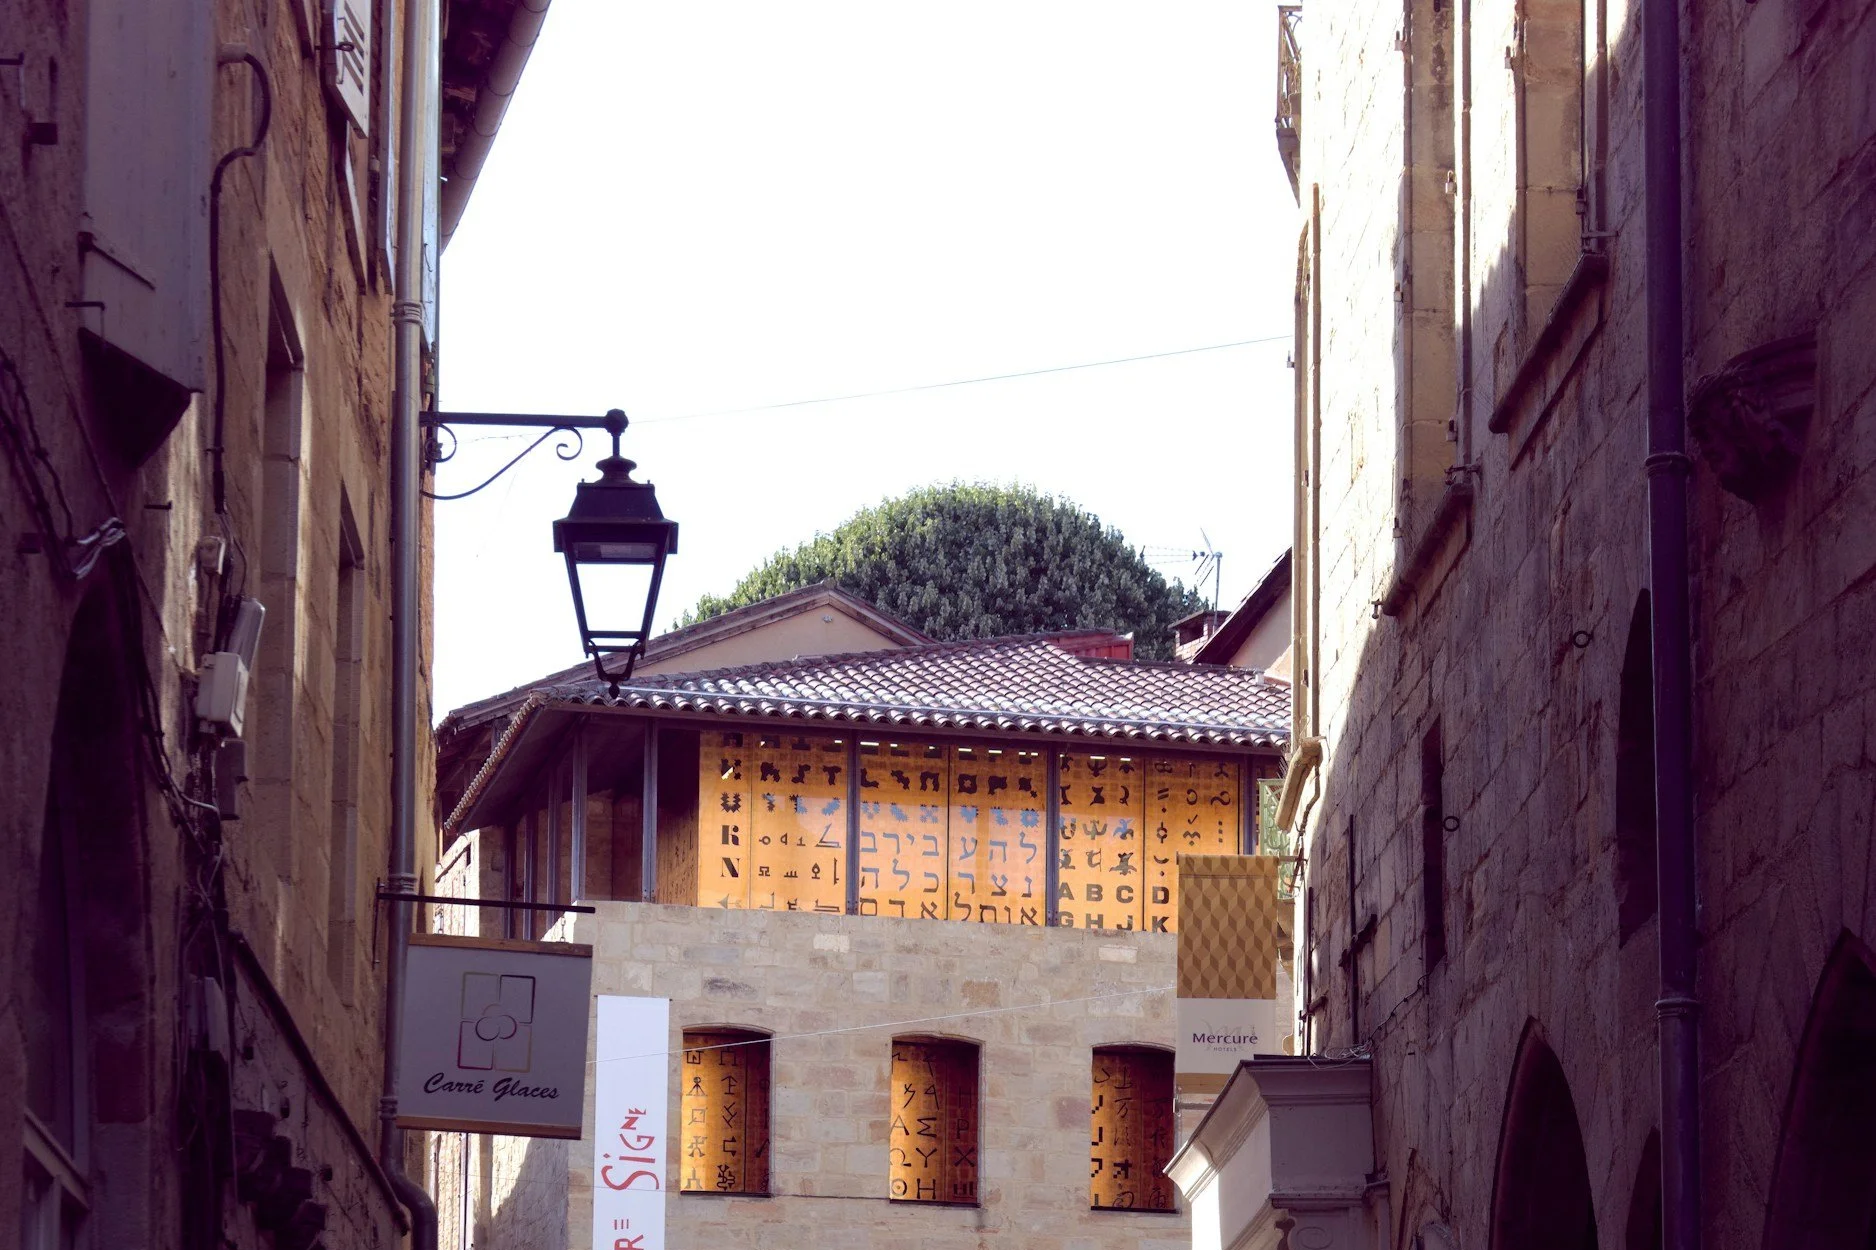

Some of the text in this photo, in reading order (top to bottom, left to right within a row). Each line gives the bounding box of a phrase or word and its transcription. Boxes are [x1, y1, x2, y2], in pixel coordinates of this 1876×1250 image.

[1191, 1032, 1259, 1045] Mercure
[423, 1072, 561, 1102] Carré Glaces
